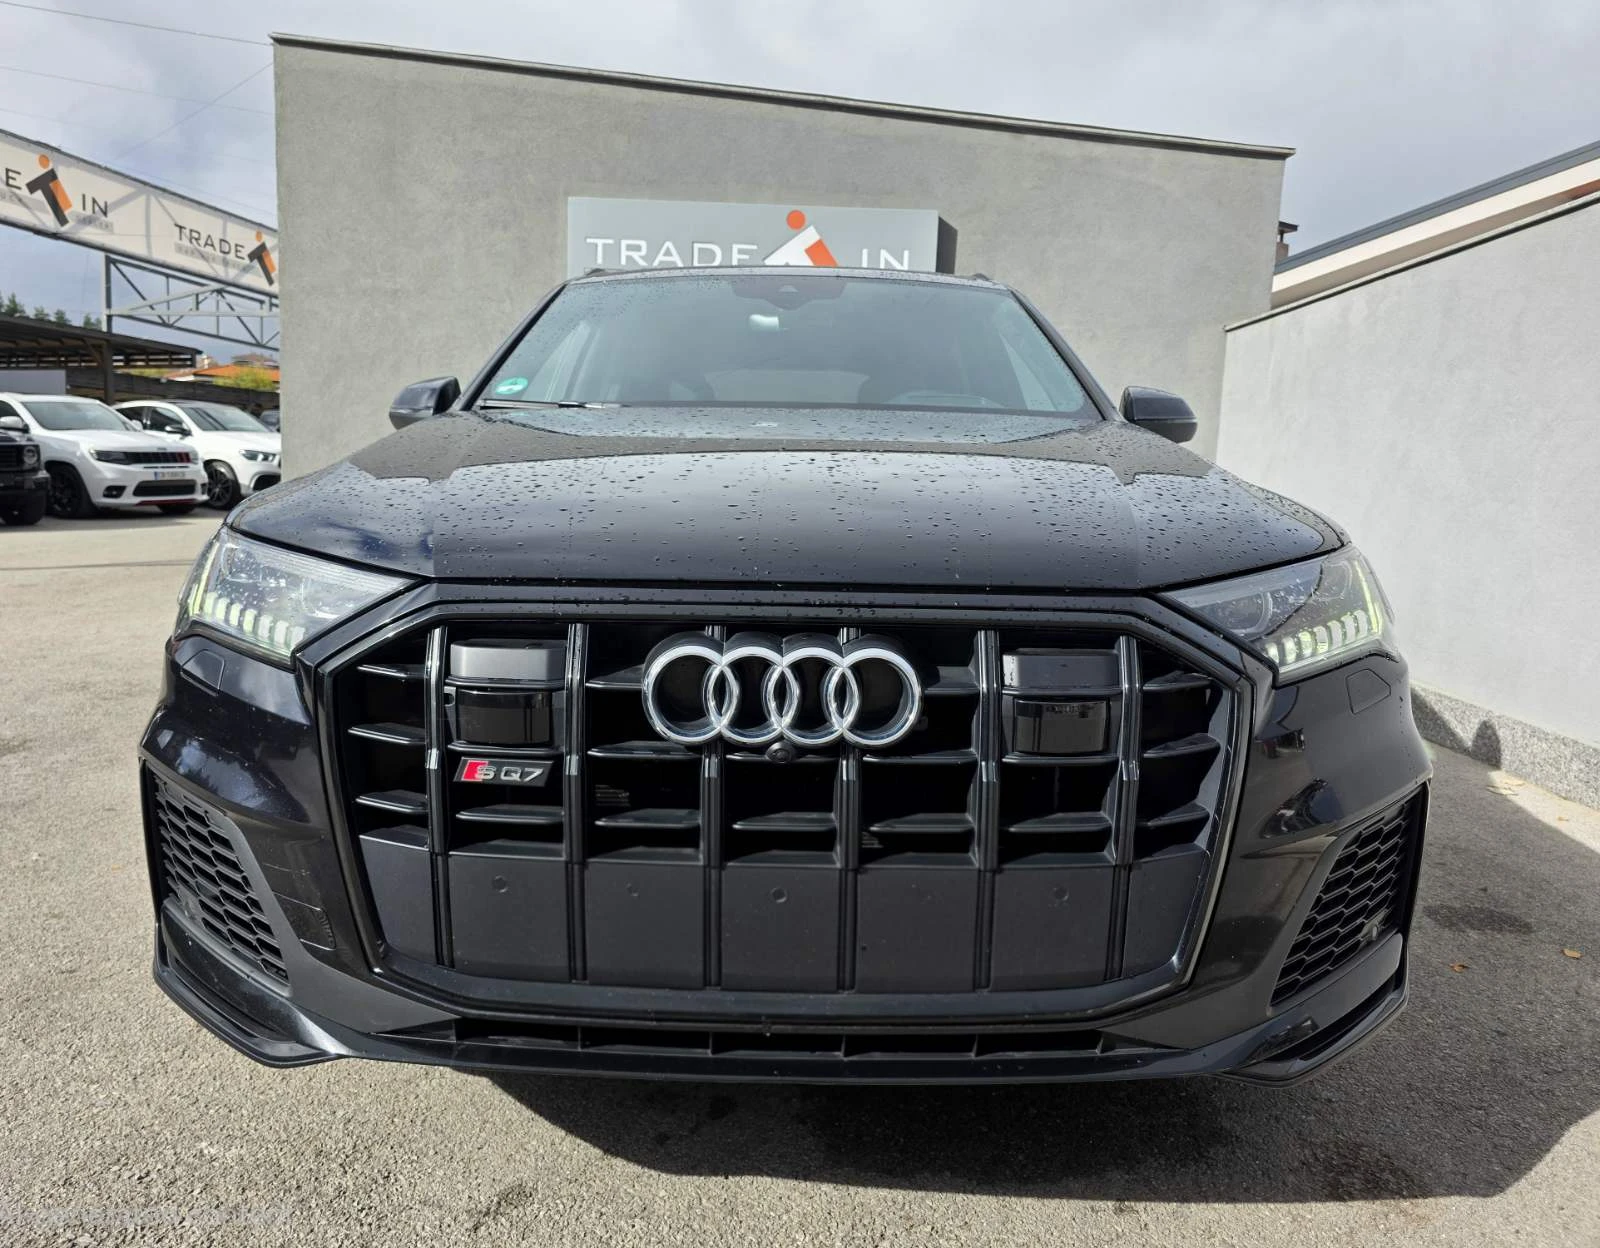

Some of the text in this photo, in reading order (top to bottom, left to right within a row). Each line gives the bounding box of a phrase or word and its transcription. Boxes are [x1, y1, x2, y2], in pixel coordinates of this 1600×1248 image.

[81, 193, 108, 217] IN
[174, 224, 246, 260] TRADE
[861, 248, 909, 270] IN
